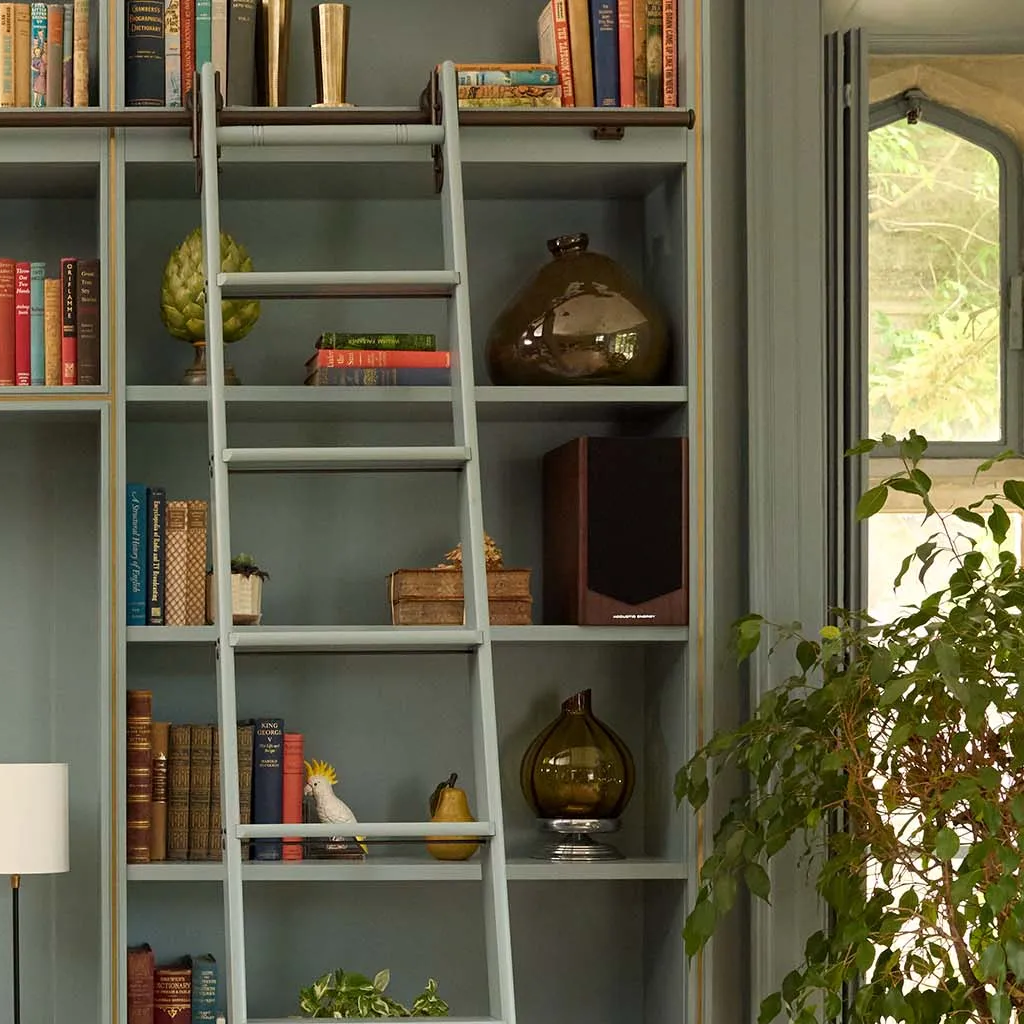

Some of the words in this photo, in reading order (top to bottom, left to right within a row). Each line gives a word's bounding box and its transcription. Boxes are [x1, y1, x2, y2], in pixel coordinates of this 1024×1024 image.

[131, 504, 140, 536] Structural
[152, 500, 160, 532] Encyclopedia
[131, 537, 140, 559] History
[131, 569, 141, 593] English
[151, 570, 160, 601] Broadcasting
